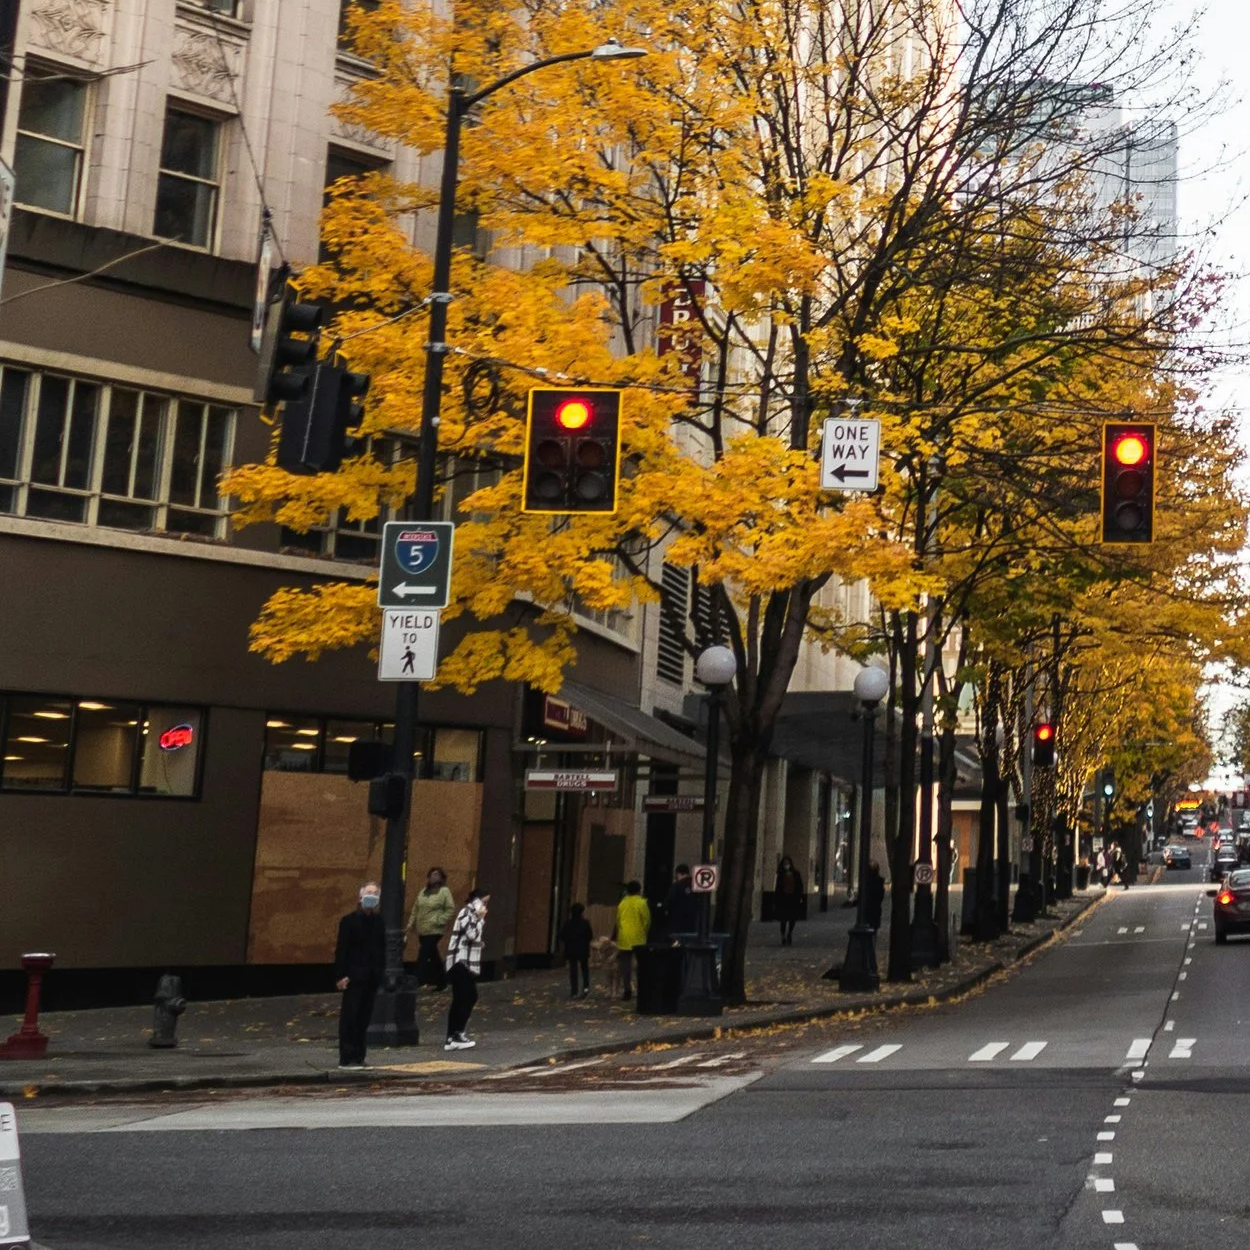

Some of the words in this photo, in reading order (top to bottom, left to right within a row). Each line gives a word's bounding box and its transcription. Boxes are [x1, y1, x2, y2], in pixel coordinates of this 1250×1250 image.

[834, 425, 869, 441] ONE
[832, 444, 869, 460] WAY
[409, 545, 424, 566] 5
[390, 616, 433, 629] YIELD
[402, 633, 417, 644] TO
